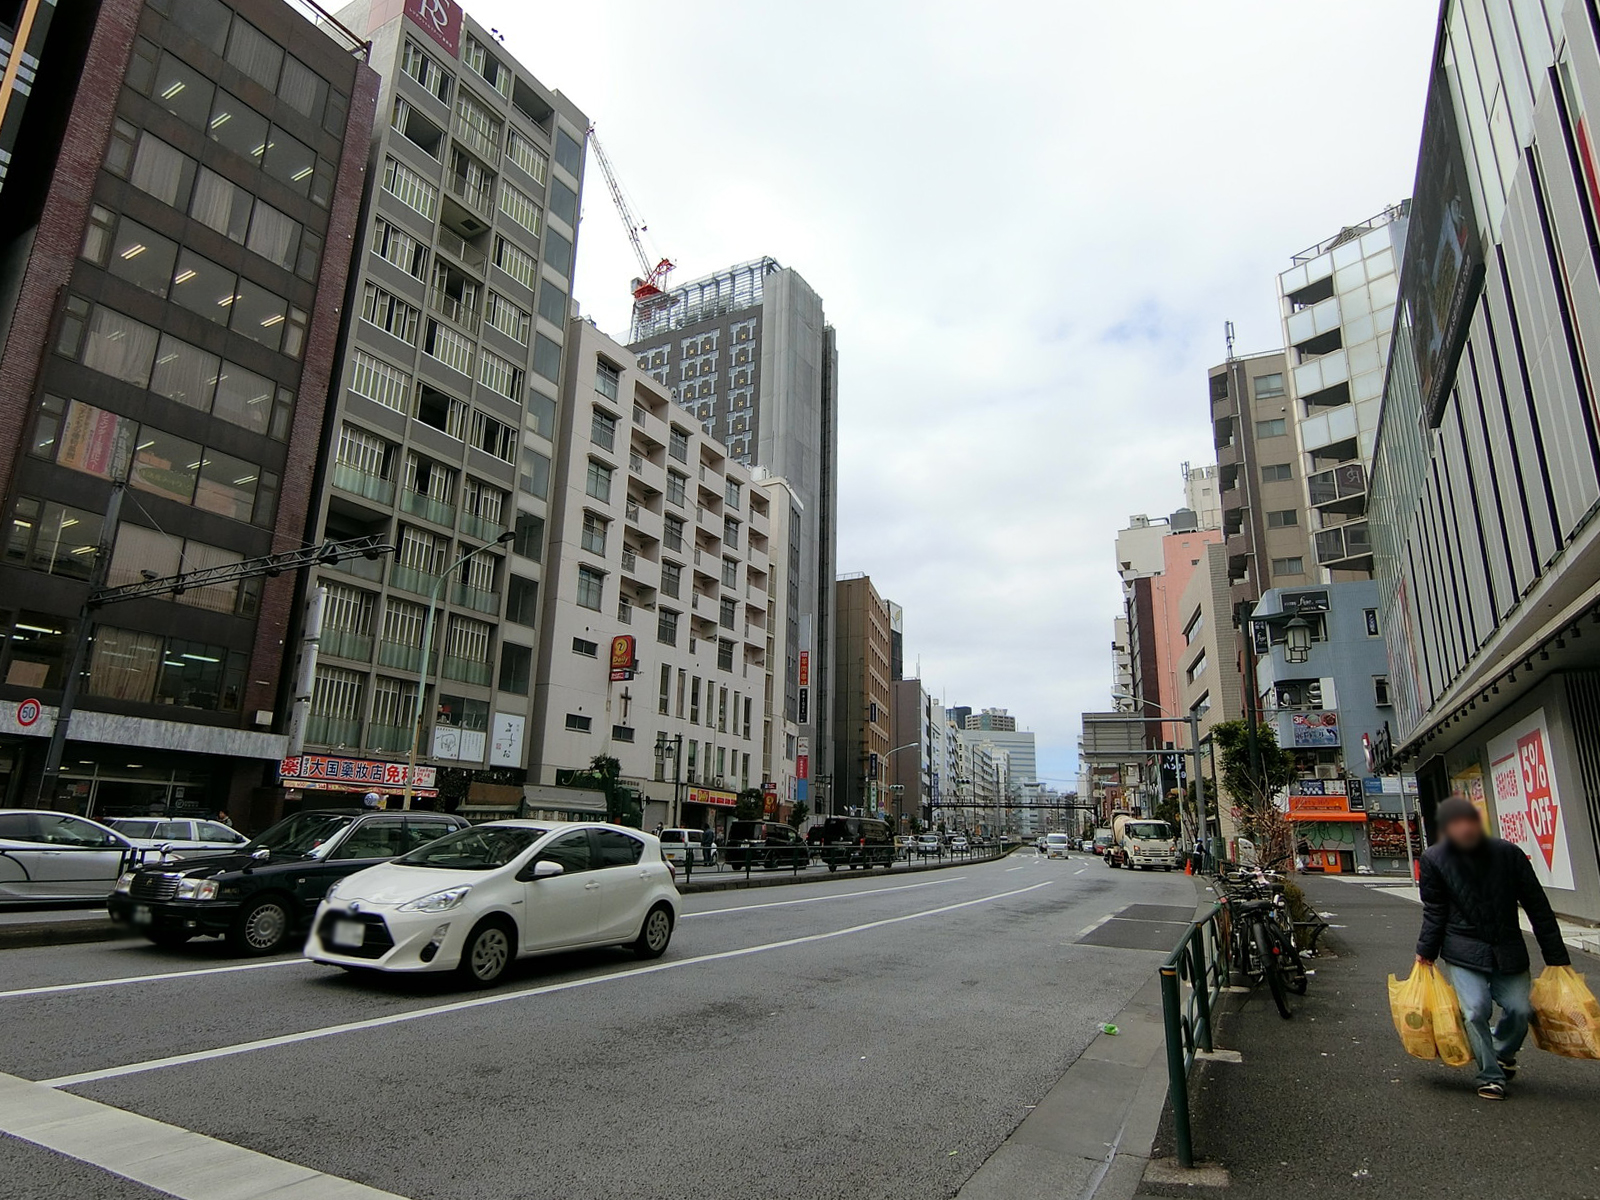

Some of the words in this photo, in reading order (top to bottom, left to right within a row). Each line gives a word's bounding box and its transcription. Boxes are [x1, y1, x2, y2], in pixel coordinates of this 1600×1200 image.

[22, 706, 36, 719] 50
[1521, 740, 1547, 793] 5%
[1530, 796, 1553, 837] OFF
